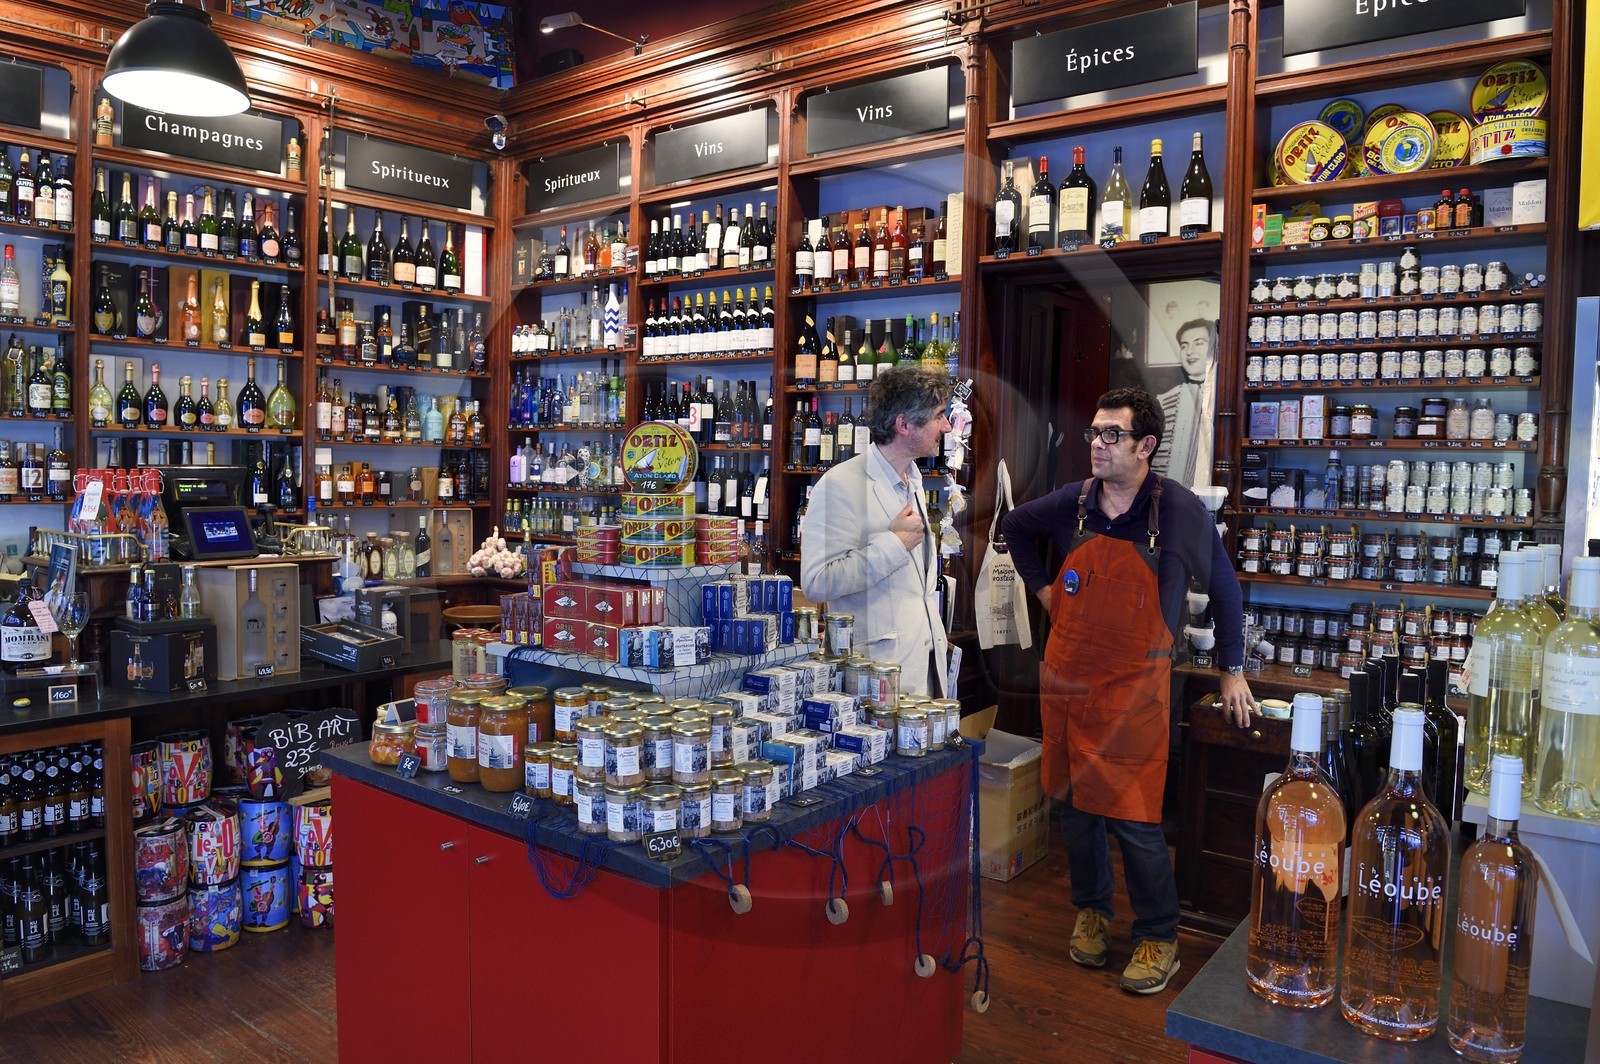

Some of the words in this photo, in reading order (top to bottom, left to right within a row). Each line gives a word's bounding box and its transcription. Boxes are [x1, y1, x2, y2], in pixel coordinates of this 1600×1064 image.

[1065, 45, 1135, 74] Épices
[1482, 70, 1537, 88] ORTIZ
[856, 104, 893, 123] Vins
[145, 114, 264, 151] Champagnes
[693, 141, 724, 158] Vins
[1285, 127, 1319, 166] ORTIZ
[371, 160, 449, 190] Spiritueux
[544, 169, 601, 194] Spiritueux
[630, 435, 678, 448] ORTIZ
[24, 469, 42, 486] 12
[640, 480, 657, 489] 17€
[317, 715, 359, 739] ART
[1358, 869, 1442, 901] Léoube
